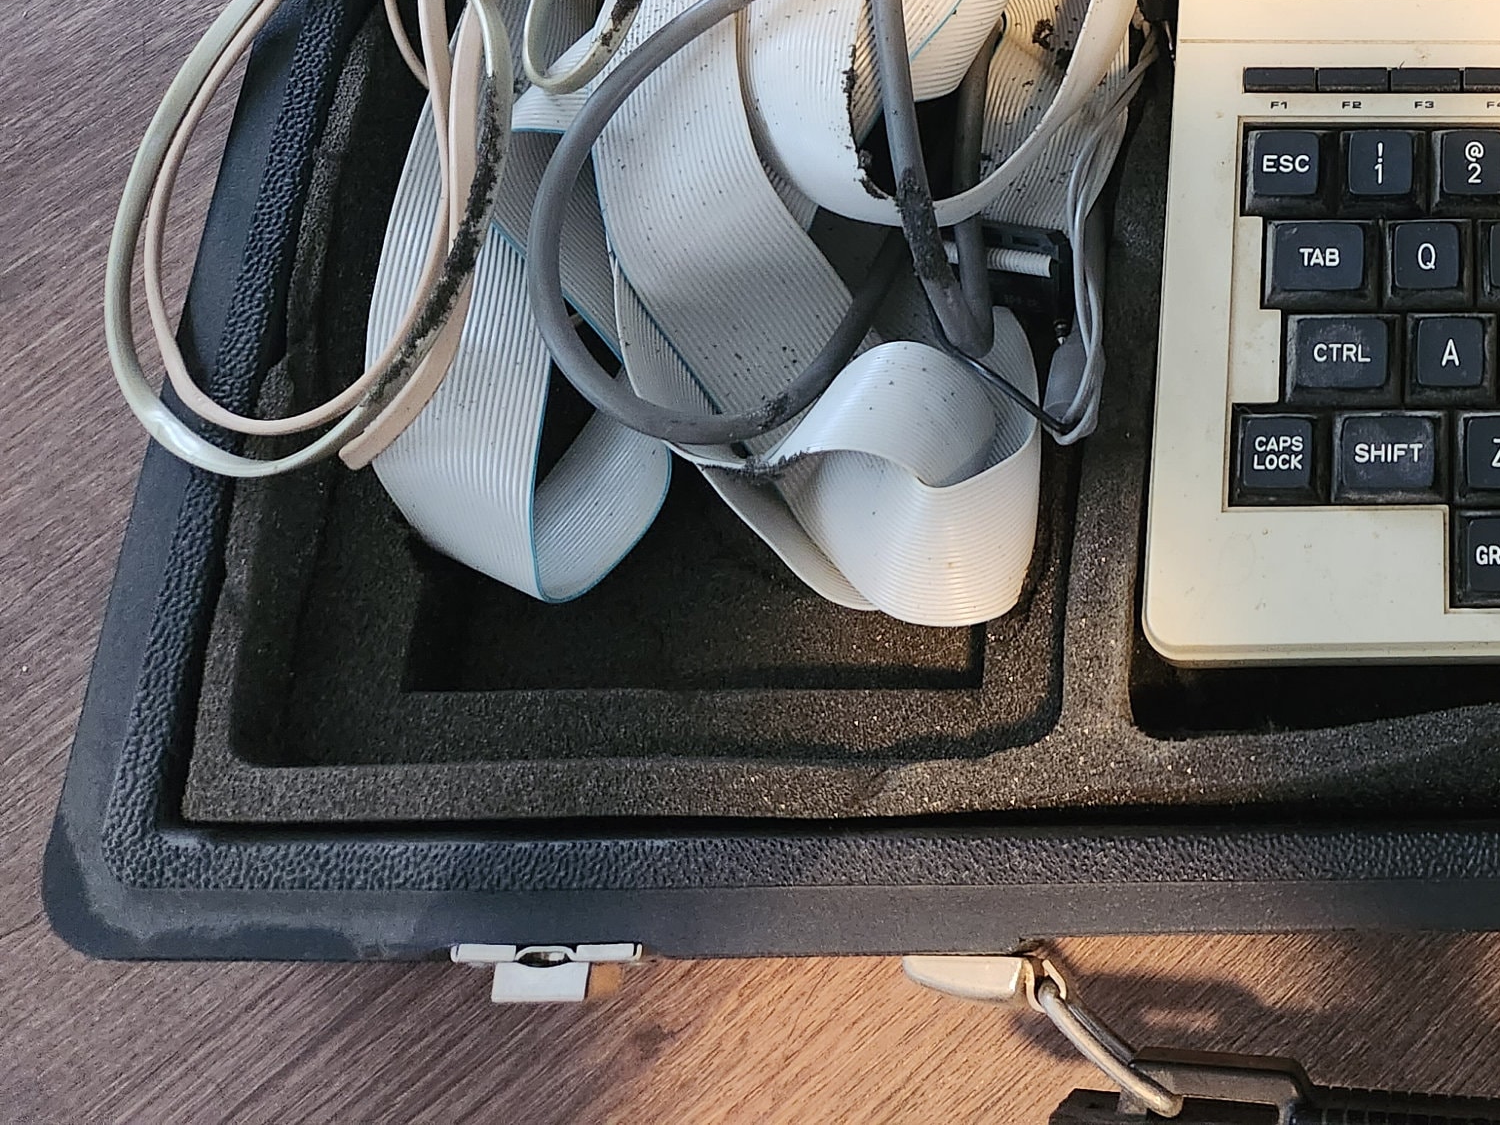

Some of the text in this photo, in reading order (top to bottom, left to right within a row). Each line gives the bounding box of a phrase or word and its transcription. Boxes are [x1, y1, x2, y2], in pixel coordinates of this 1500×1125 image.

[1270, 101, 1288, 110] F1
[1341, 101, 1362, 109] F2
[1414, 100, 1434, 109] F3
[1377, 142, 1383, 163] !
[1465, 141, 1484, 162] @
[1262, 154, 1310, 173] ESC
[1374, 163, 1383, 184] 1
[1468, 162, 1482, 184] 2
[1299, 247, 1340, 267] TAB
[1417, 243, 1436, 270] Q
[1313, 343, 1371, 363] CTRL
[1441, 338, 1460, 367] A
[1254, 435, 1304, 452] CAPS
[1354, 443, 1423, 463] SHIFT
[1253, 454, 1303, 470] LOCK
